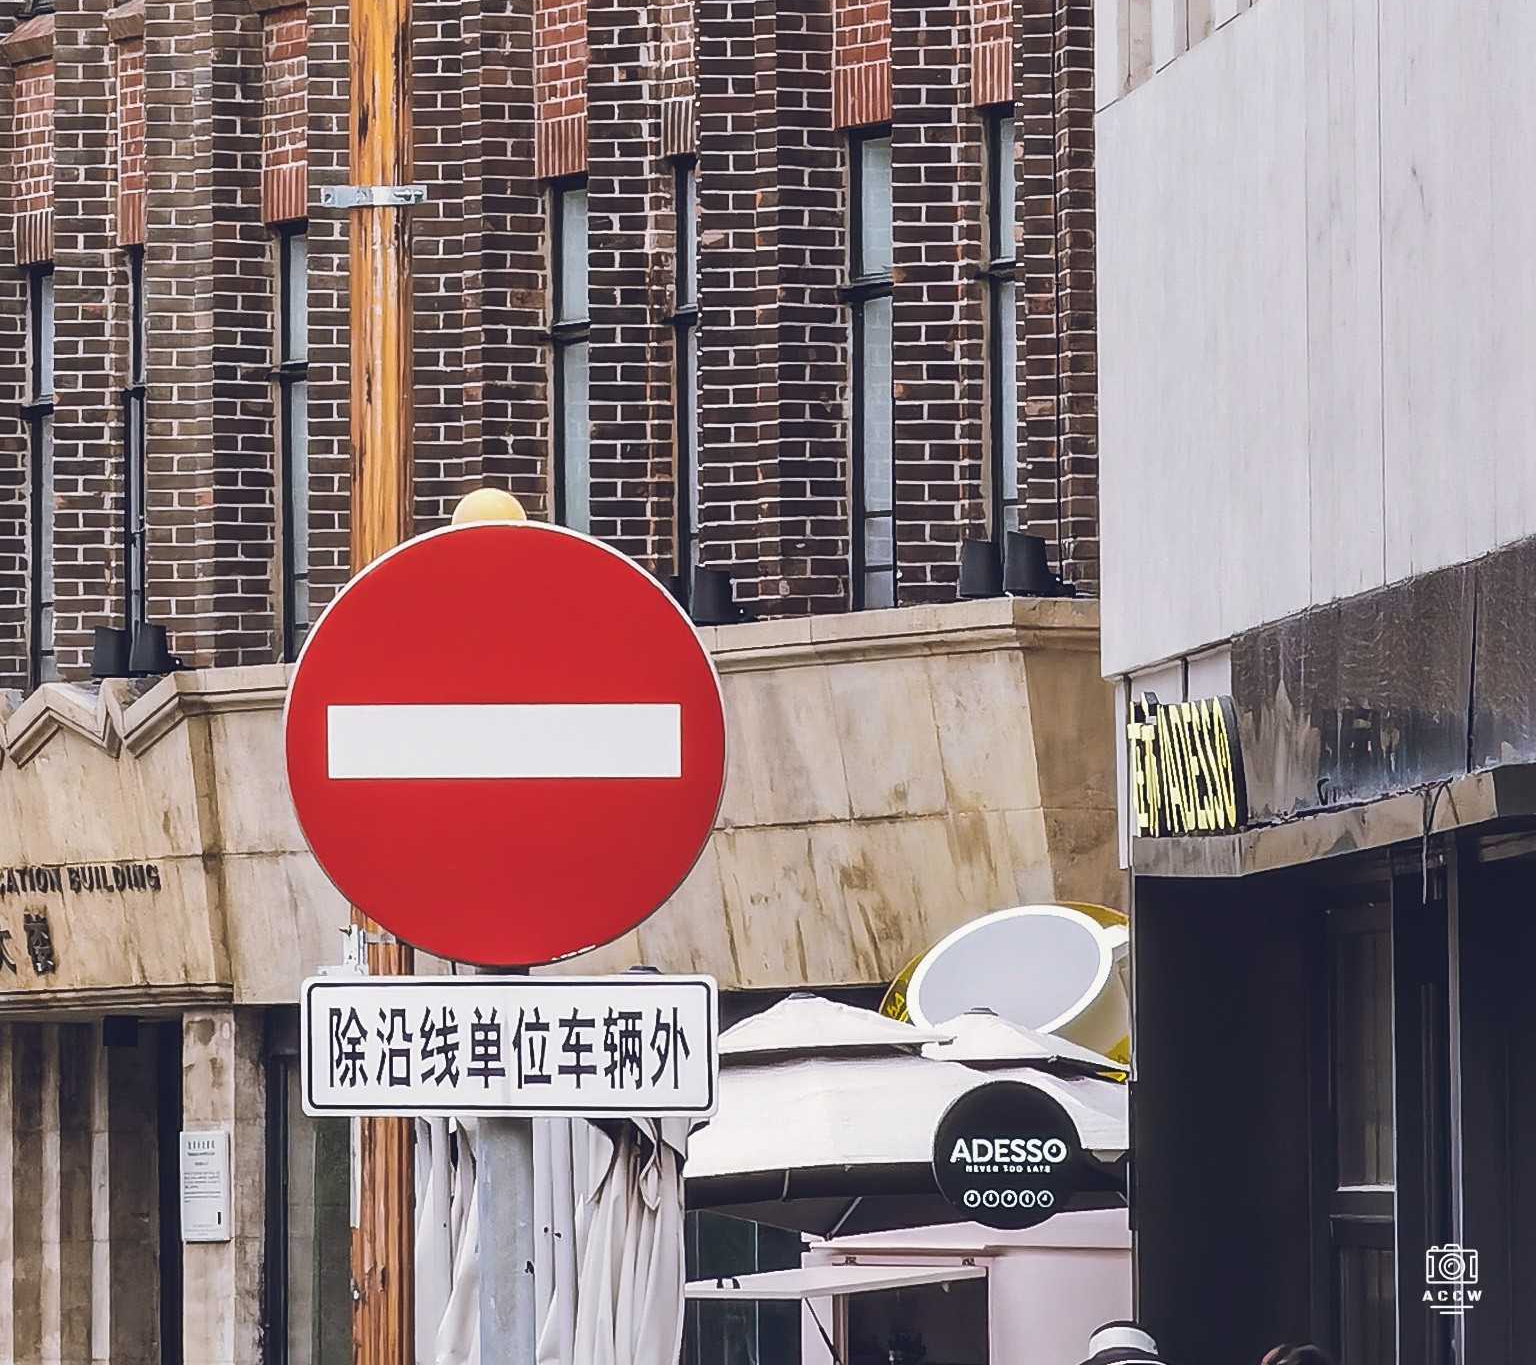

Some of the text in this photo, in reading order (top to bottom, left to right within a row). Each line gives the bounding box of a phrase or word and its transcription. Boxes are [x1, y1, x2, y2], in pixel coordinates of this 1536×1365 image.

[67, 864, 162, 894] BUILDING
[328, 1006, 690, 1090] 除沿线单位车辆外
[949, 1138, 1067, 1163] ADESSO
